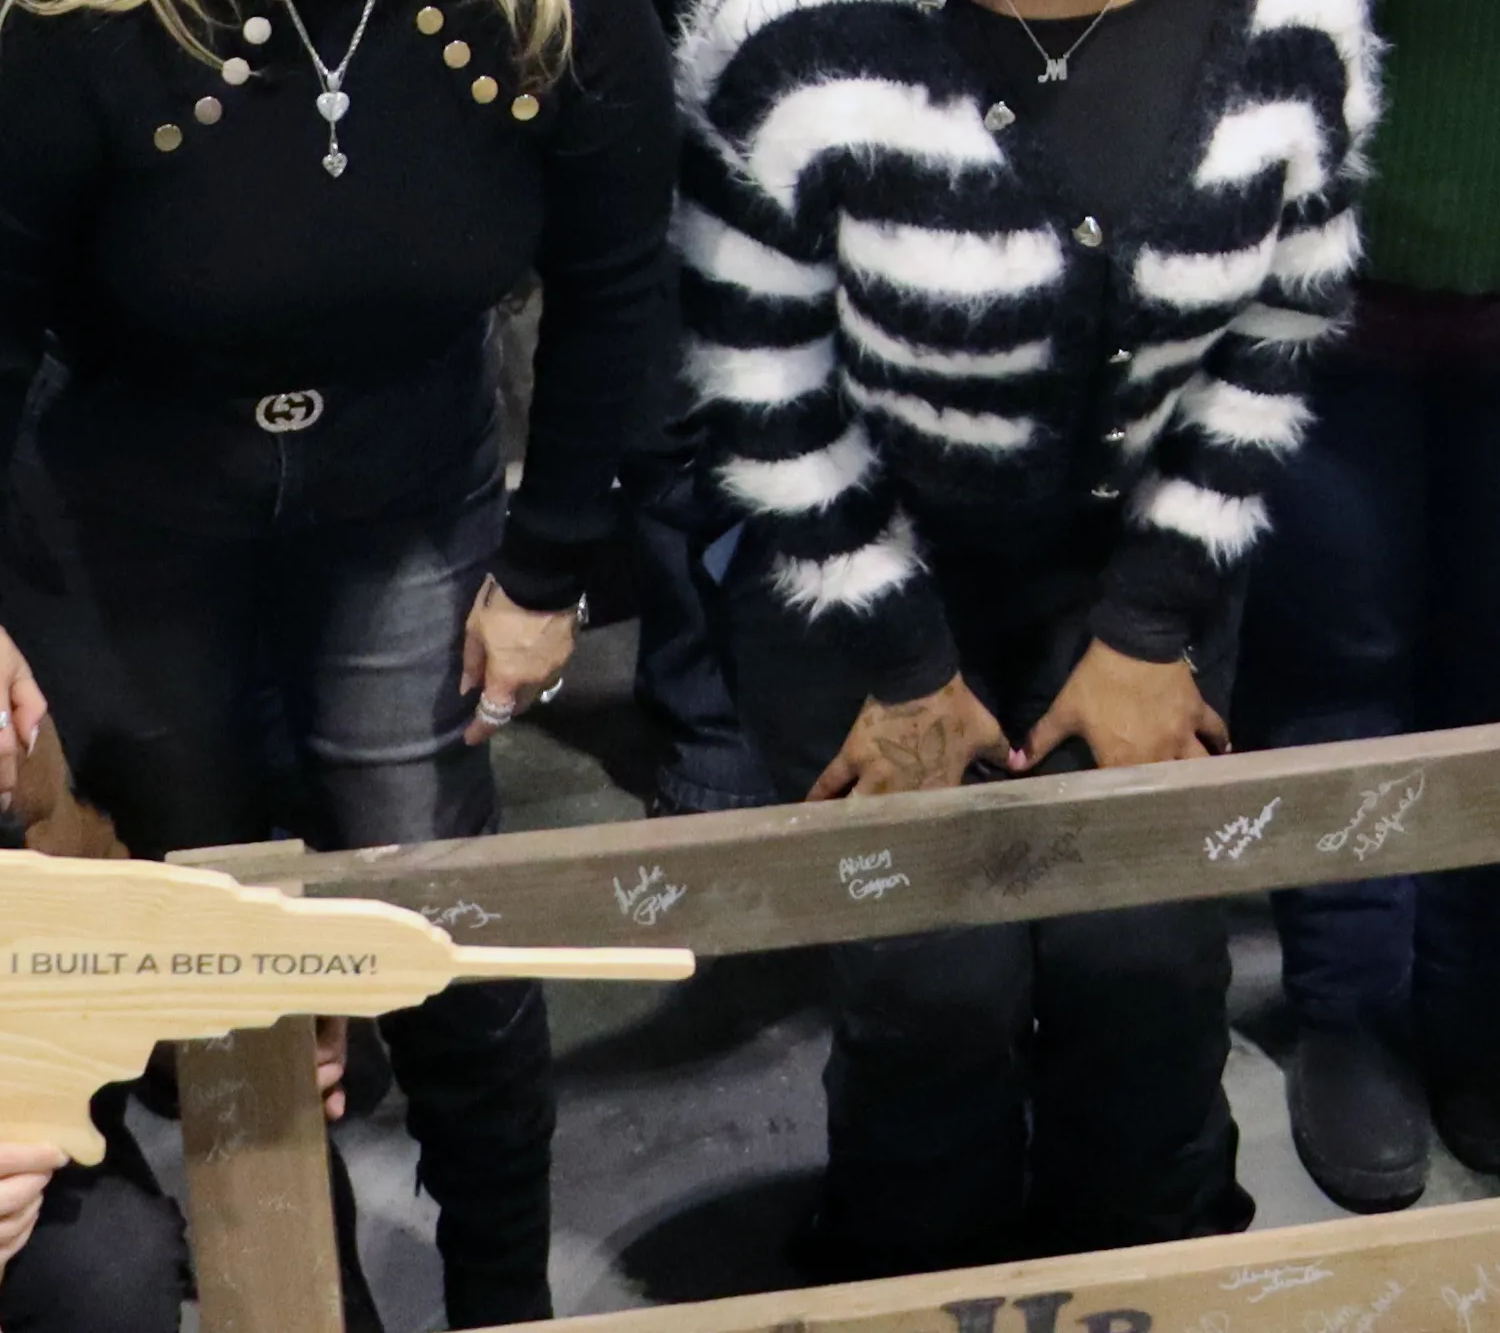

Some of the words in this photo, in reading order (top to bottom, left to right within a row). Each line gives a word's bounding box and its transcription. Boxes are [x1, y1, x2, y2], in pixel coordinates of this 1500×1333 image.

[10, 951, 19, 975] I
[31, 952, 129, 975] BUILT
[136, 952, 161, 975] A
[170, 953, 242, 975] BED
[252, 952, 379, 976] TODAY!
